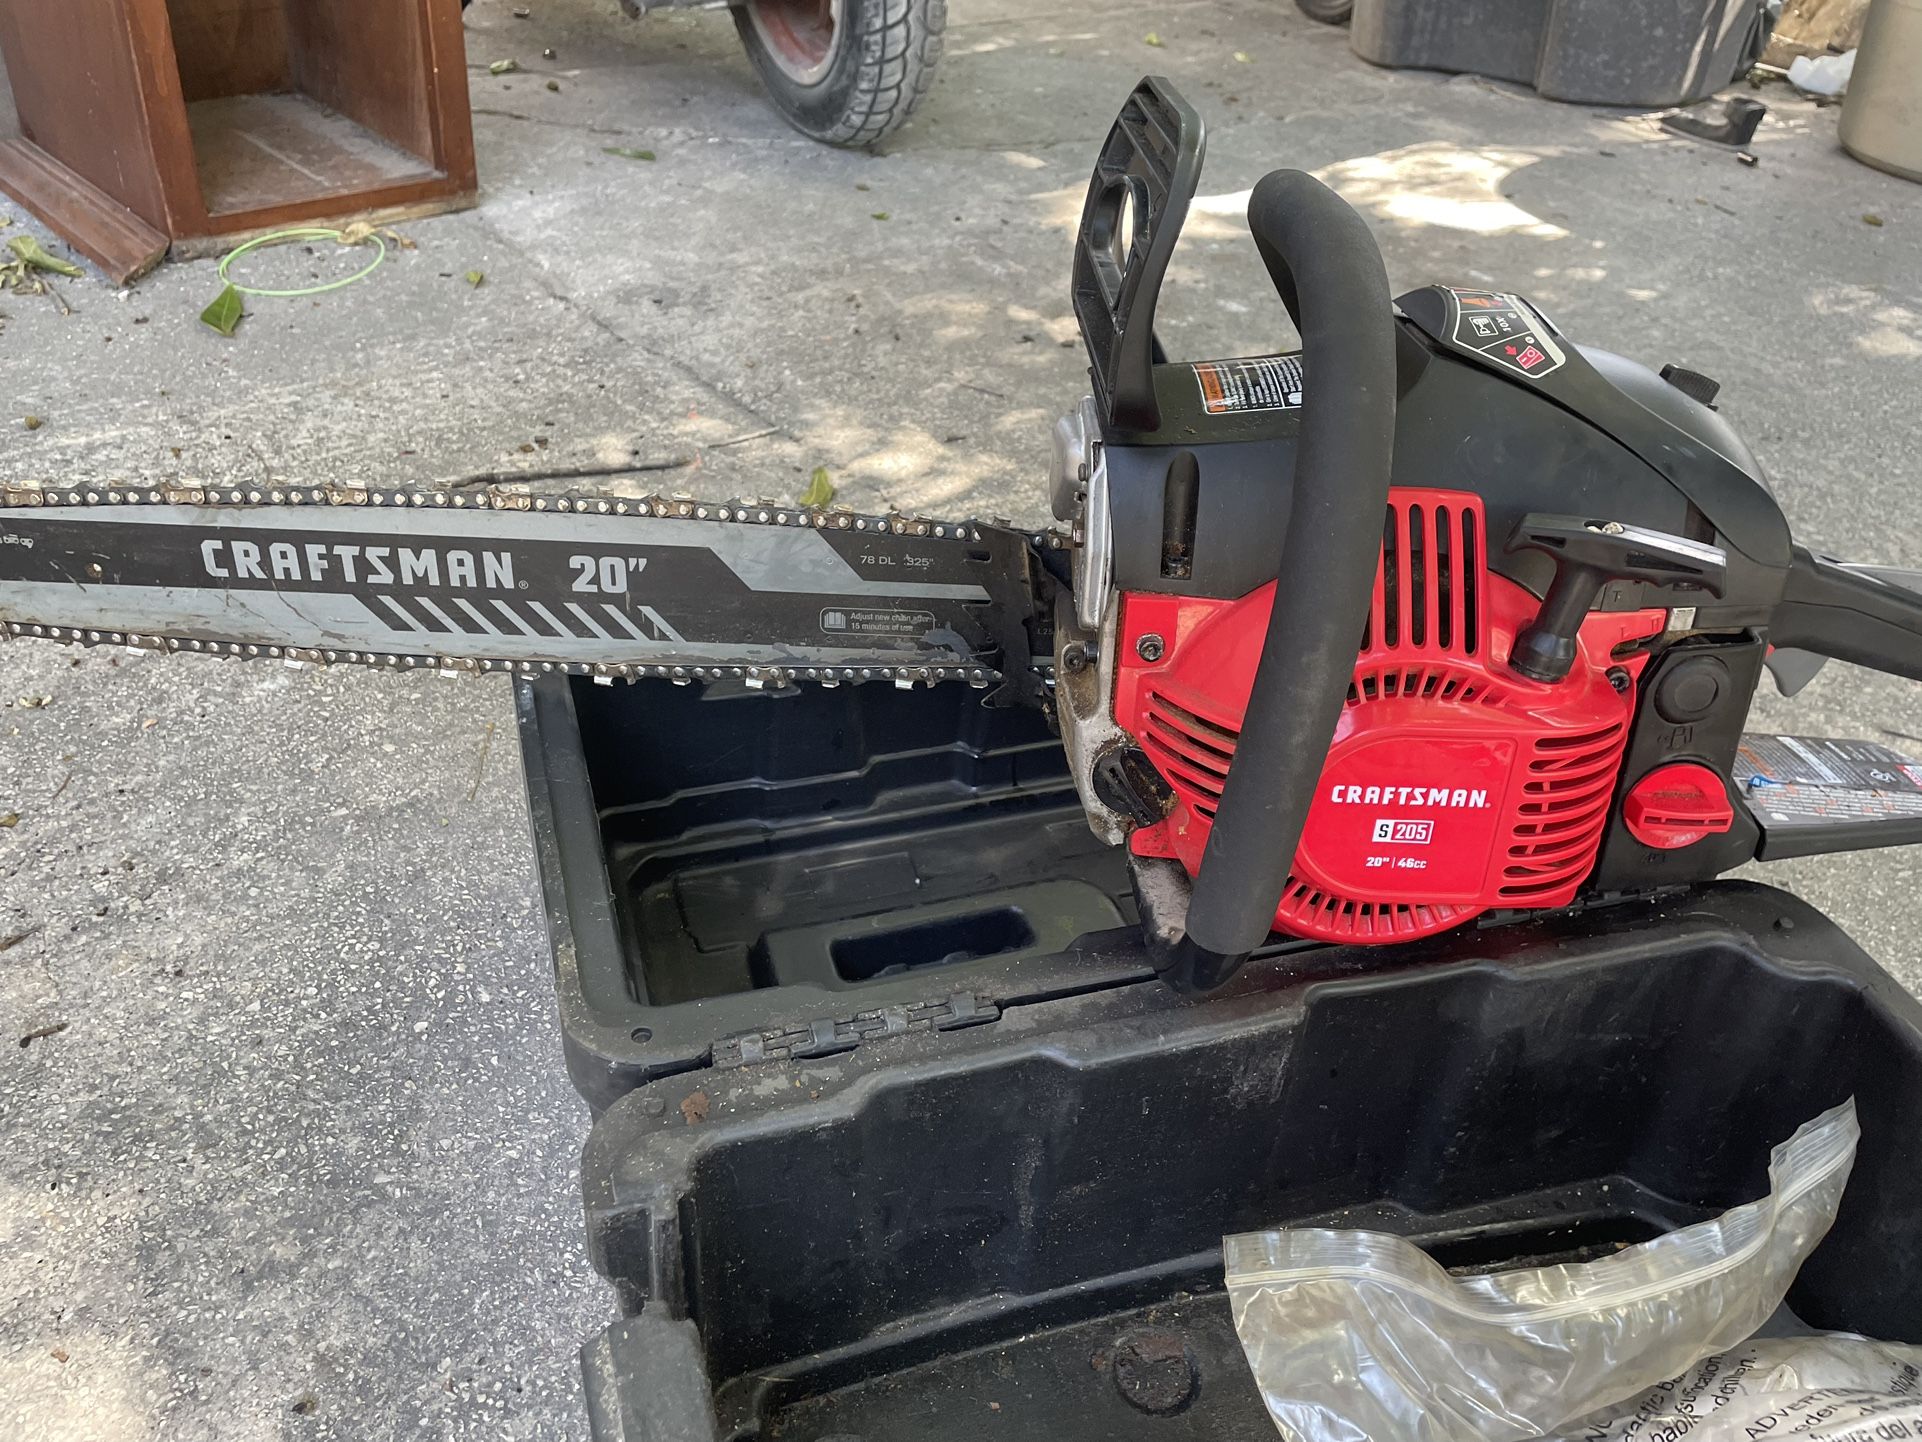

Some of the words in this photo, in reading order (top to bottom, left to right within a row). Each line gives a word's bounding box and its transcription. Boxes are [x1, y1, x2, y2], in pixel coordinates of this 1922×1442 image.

[200, 539, 515, 589] CRAFTSMAN
[860, 555, 875, 565] 78
[879, 556, 897, 565] DL
[850, 612, 873, 621] Adjust
[875, 613, 890, 621] new
[851, 622, 860, 630] 15
[861, 623, 890, 631] minutes
[891, 623, 899, 631] of
[1331, 785, 1487, 808] CRAFTSMAN
